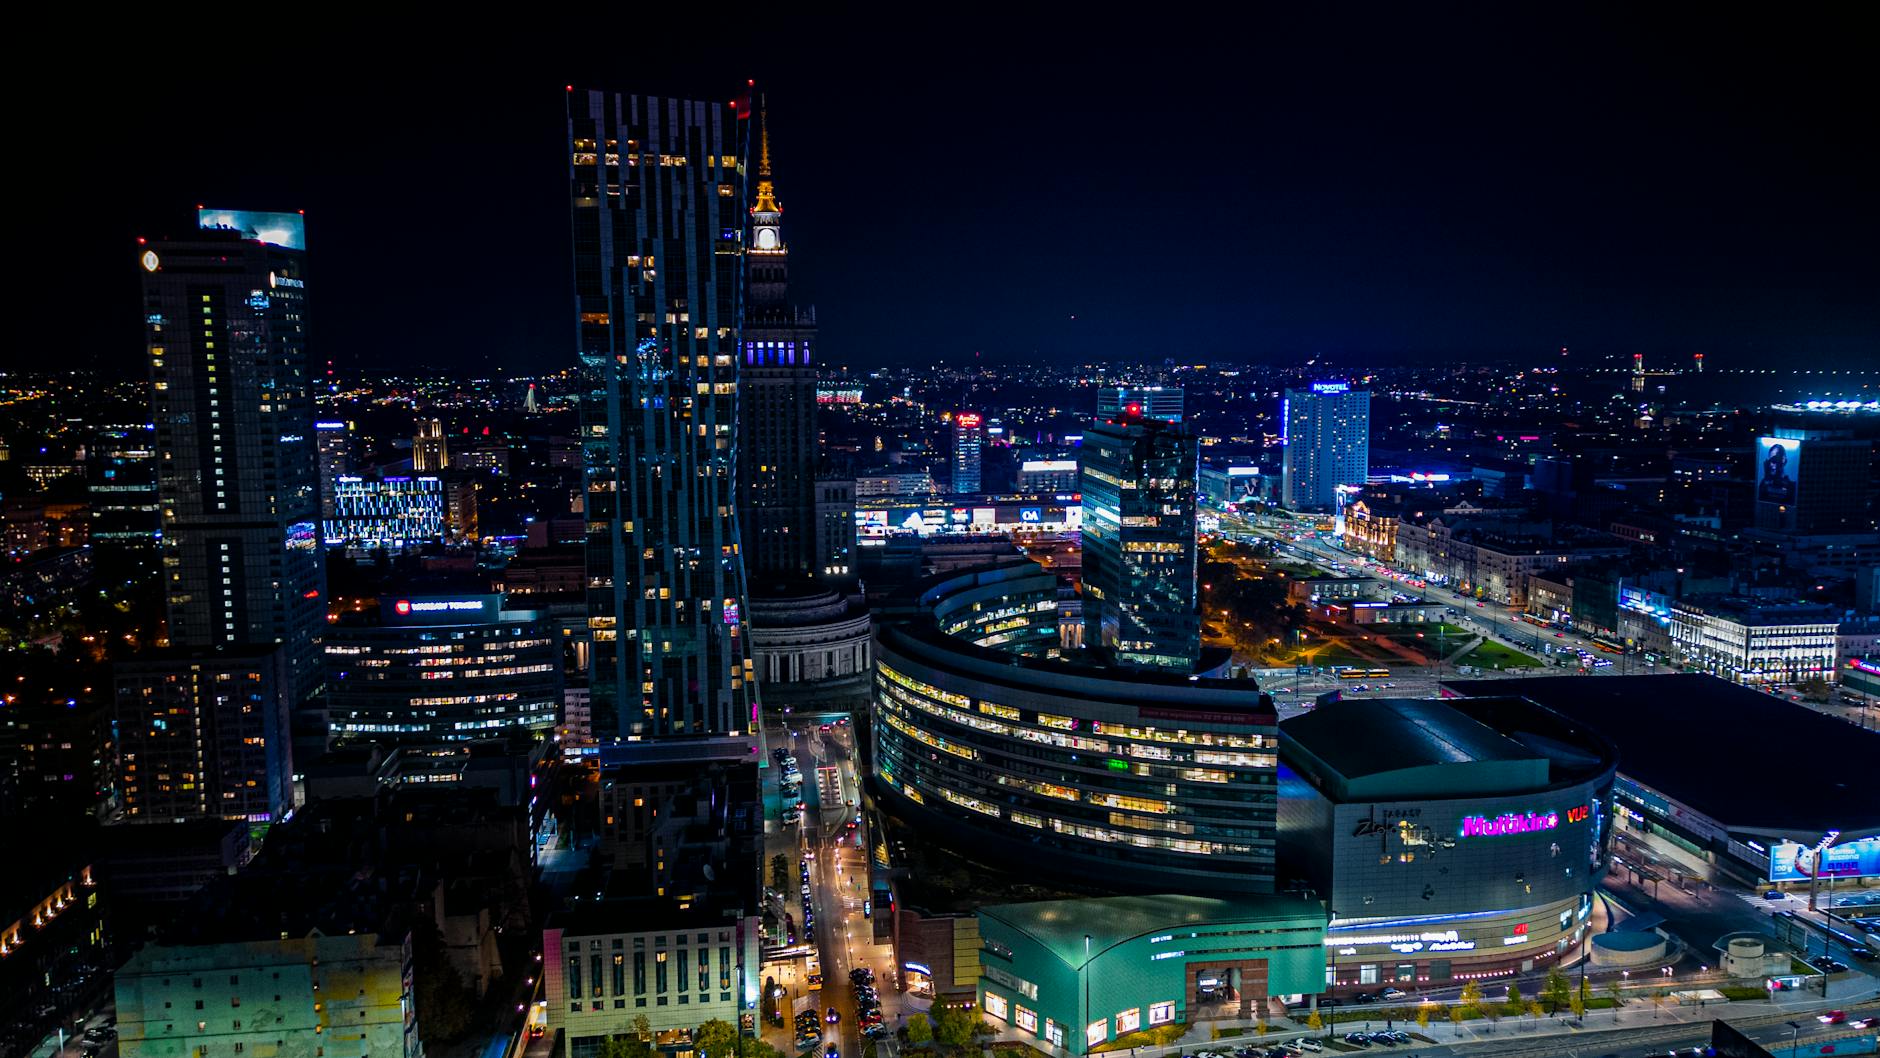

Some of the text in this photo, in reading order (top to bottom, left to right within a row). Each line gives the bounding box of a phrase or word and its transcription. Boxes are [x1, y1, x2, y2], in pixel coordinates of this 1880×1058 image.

[1313, 383, 1349, 391] NOVOTEL
[448, 601, 483, 610] TOWERS
[1463, 813, 1559, 836] Multikino
